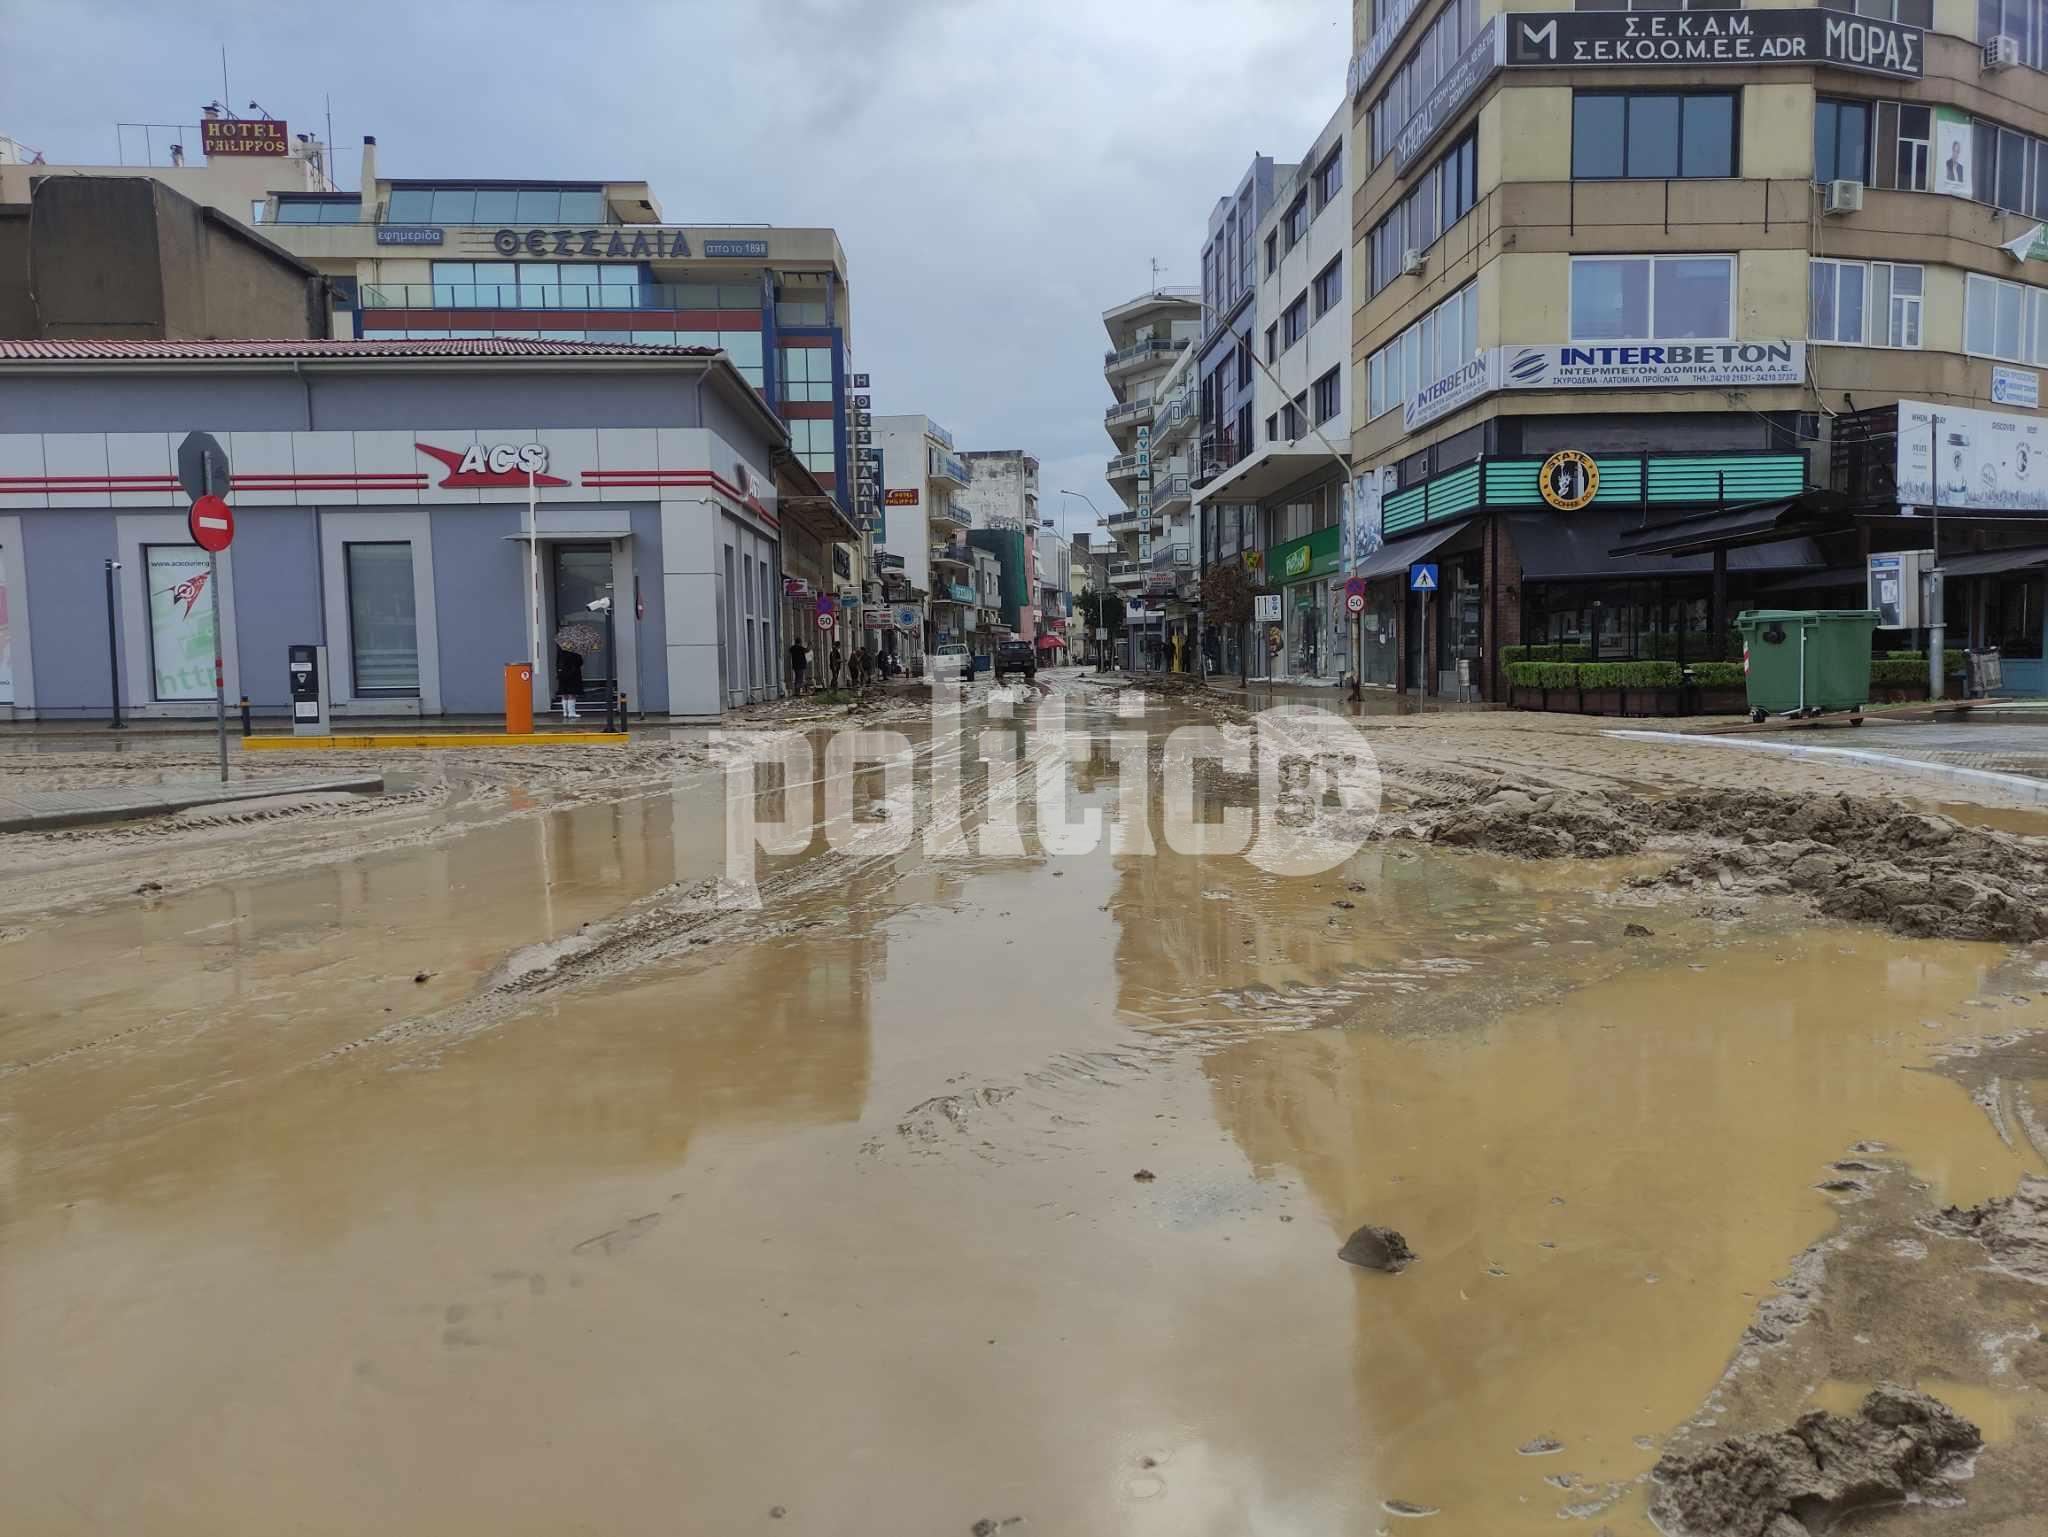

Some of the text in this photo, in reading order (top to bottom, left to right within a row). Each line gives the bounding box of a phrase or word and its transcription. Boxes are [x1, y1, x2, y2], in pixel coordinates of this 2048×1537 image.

[1625, 16, 1754, 37] Σ.Ε.Κ.Α.Μ.
[1574, 37, 1807, 60] Σ.Ε.Κ.Ο.Ο.Μ.Ε.Ε. ADR
[1826, 17, 1918, 73] ΜΟΡΑΣ
[208, 123, 280, 137] HOTEL
[206, 139, 286, 152] PHILIPPOS
[494, 229, 692, 257] ΘΕΣΣΑΛΙΑ
[1561, 344, 1792, 366] INTERBETON
[1552, 376, 1598, 385] ΣΚΥΡΟΔΕΜΑ
[1603, 375, 1641, 384] ΛΑΤΟΜΙΚΑ
[1559, 364, 1793, 376] ΙΝΤΕΡΜΠΕΤΟΝ ΔΟΜΙΚΑ ΥΛΙΚΑ Α.Ε.
[1418, 355, 1487, 408] INTERBETON
[457, 444, 546, 474] ACS
[857, 375, 871, 530] Η ΘΕΣΣΑΛΙΑ
[1139, 427, 1149, 558] AVRA HOTEL
[1349, 598, 1362, 607] 50
[820, 617, 831, 625] 50
